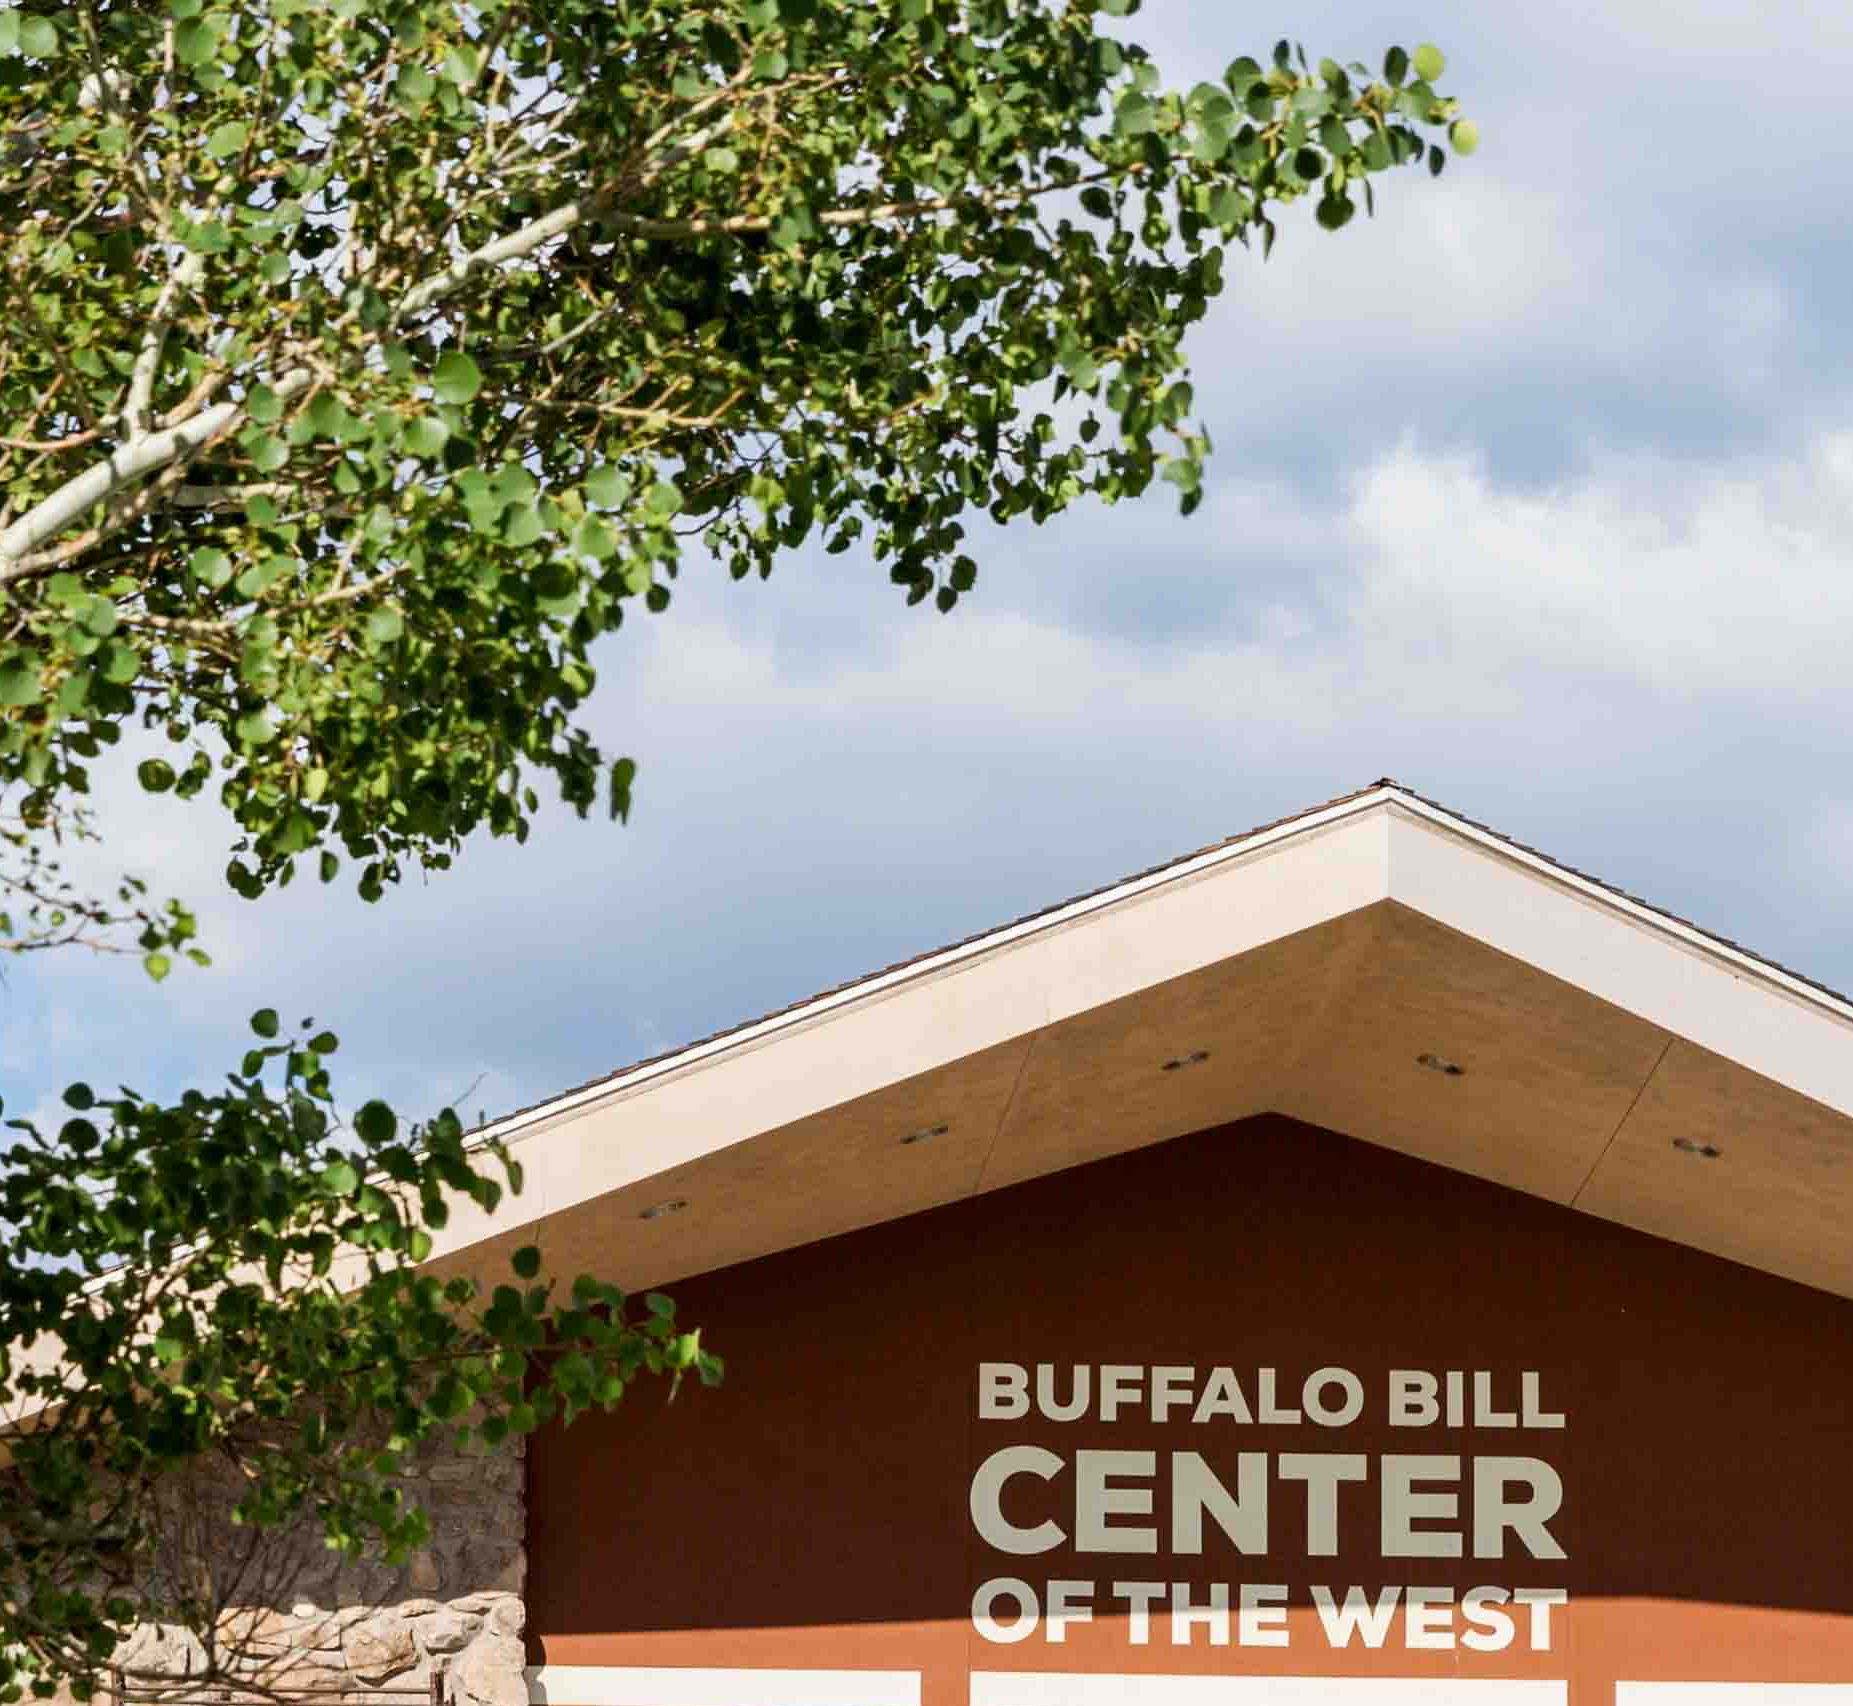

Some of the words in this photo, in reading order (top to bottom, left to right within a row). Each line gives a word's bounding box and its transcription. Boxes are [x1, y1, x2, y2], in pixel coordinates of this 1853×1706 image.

[979, 1362, 1364, 1427] BUFFALO
[1388, 1370, 1565, 1428] BILL
[969, 1445, 1568, 1560] CENTER
[971, 1577, 1094, 1644] OF
[1113, 1581, 1290, 1648] THE
[1309, 1585, 1568, 1652] WEST
